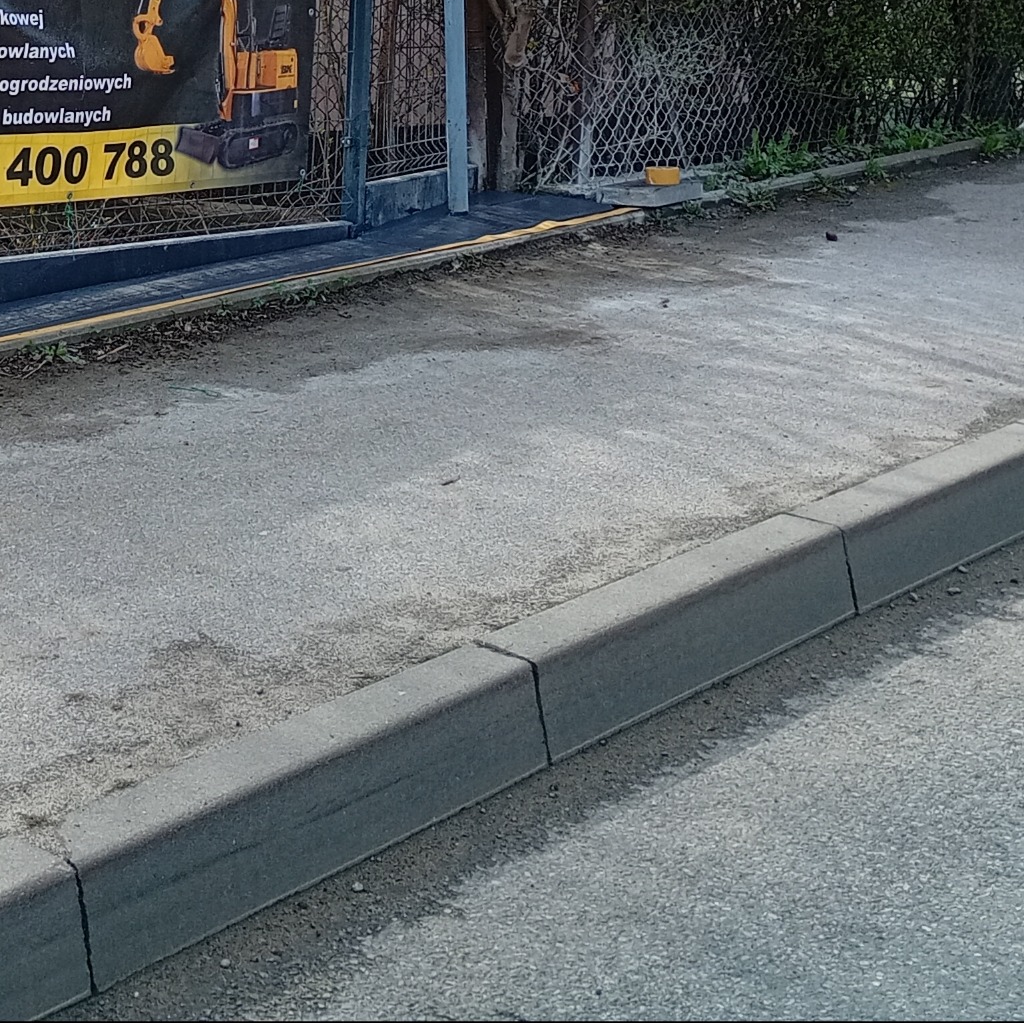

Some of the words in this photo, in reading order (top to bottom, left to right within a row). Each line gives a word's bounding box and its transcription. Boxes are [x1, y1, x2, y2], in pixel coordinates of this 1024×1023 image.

[2, 106, 112, 127] budowlanych
[6, 145, 89, 187] 400
[103, 138, 175, 179] 788
